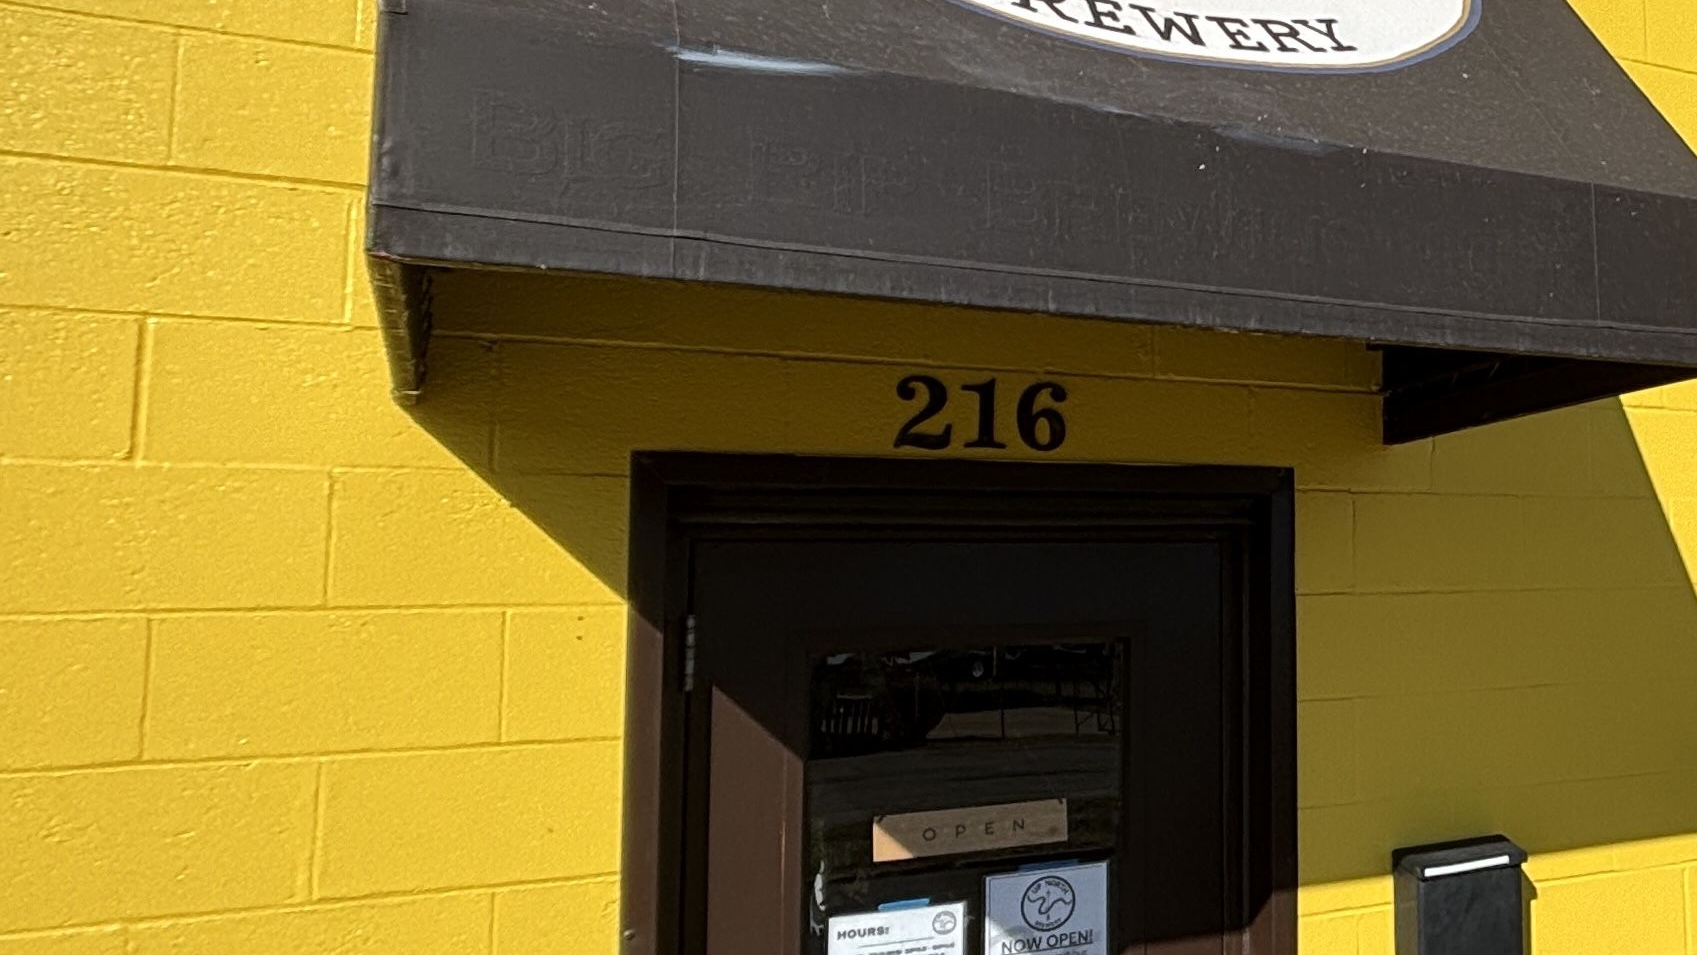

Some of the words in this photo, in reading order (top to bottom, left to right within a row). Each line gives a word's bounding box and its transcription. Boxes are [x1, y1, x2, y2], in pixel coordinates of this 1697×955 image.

[893, 375, 1067, 451] 216
[922, 818, 1025, 842] OPEN
[1001, 936, 1042, 954] NOW
[1046, 929, 1093, 947] OPEN!
